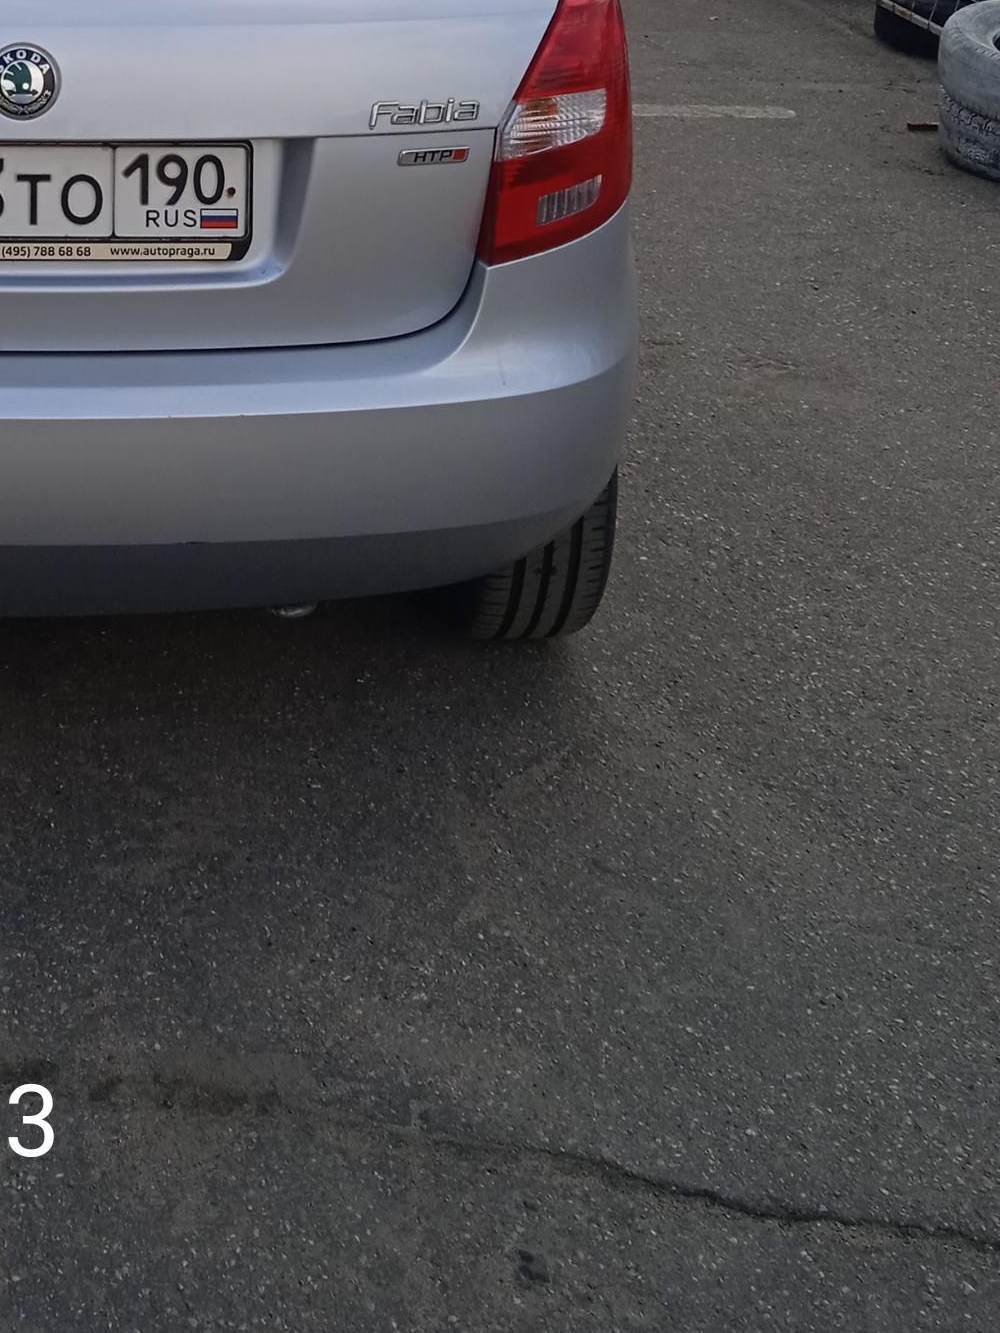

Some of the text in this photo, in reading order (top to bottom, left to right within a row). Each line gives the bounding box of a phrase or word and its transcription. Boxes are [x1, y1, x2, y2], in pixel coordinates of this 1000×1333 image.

[369, 98, 480, 130] Fabia
[413, 150, 452, 163] HTP
[124, 154, 224, 205] 190
[146, 210, 196, 227] RUS
[1, 246, 31, 258] (495)
[33, 246, 54, 257] 788
[58, 246, 74, 257] 68
[76, 246, 92, 257] 68
[110, 245, 216, 258] www.autopraga.ru
